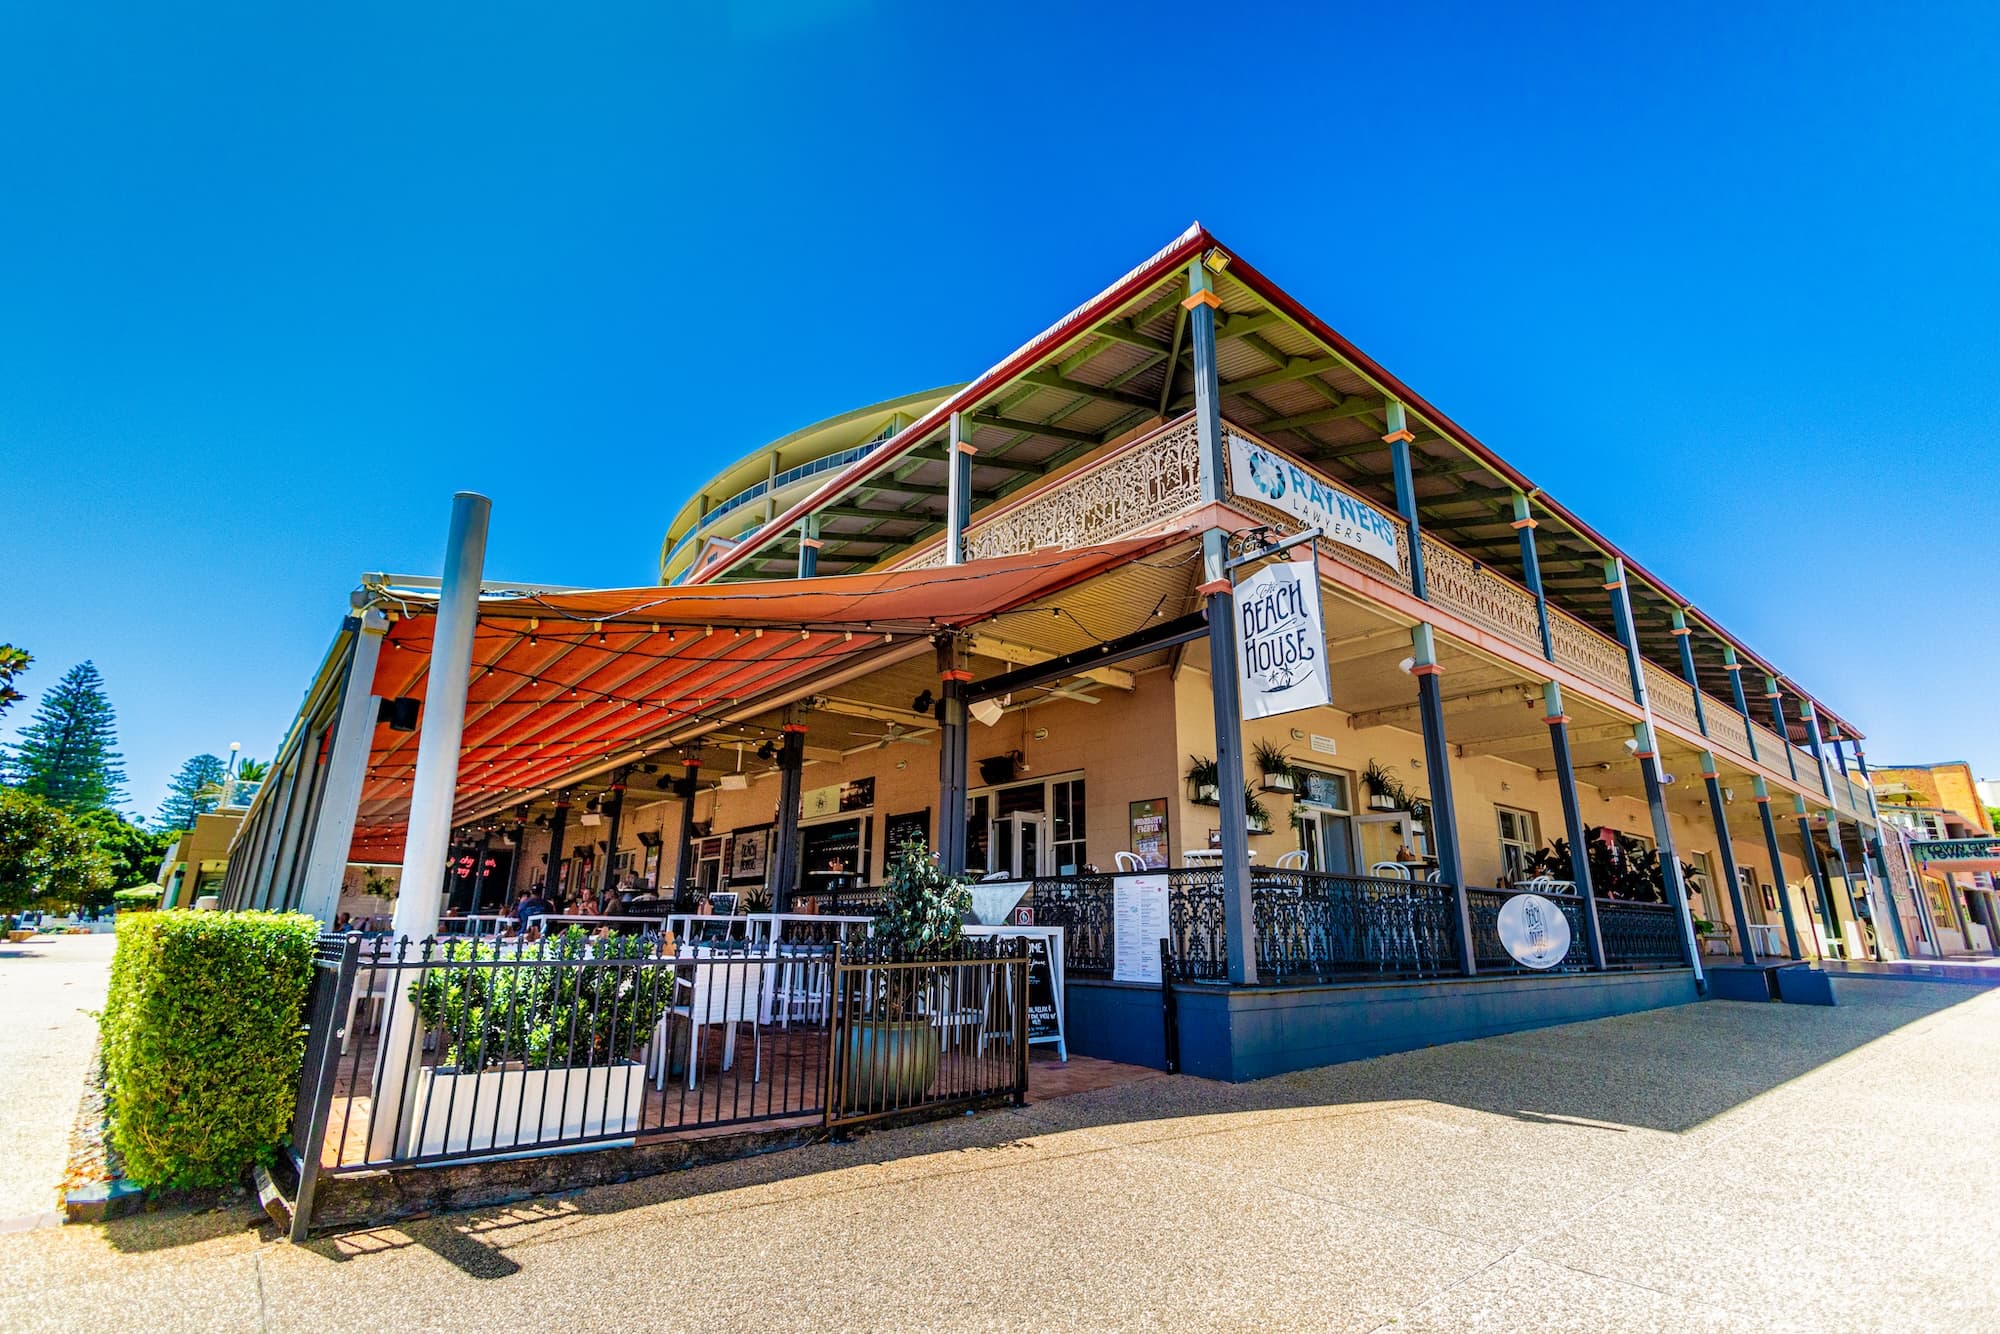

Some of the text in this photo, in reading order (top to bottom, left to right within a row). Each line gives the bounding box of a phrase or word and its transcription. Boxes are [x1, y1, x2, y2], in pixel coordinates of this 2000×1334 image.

[1288, 465, 1394, 547] RAYNERS
[1293, 497, 1363, 543] LAWYERS
[1242, 579, 1308, 640] BEACH
[1245, 628, 1315, 679] HOUSE
[1926, 844, 1965, 855] TOWN
